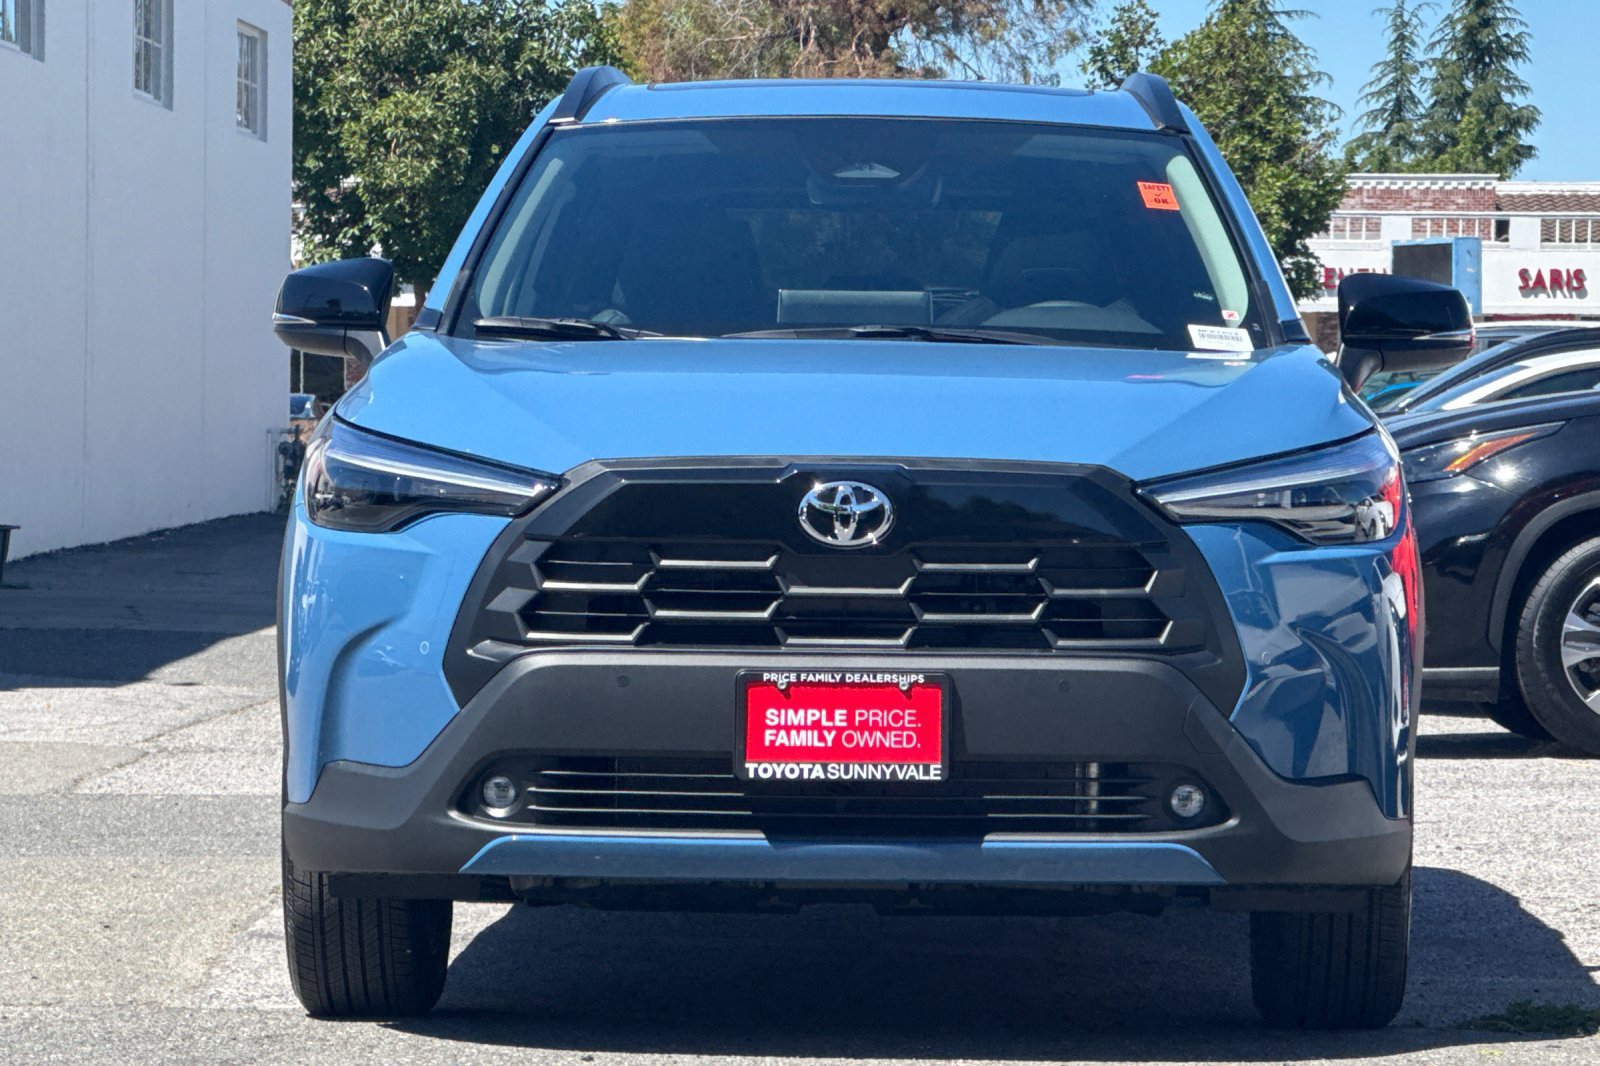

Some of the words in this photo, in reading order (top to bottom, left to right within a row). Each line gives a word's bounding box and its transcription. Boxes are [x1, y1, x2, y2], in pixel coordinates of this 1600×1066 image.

[1518, 268, 1585, 292] SARIS
[763, 672, 797, 682] PRICE
[800, 673, 842, 682] FAMILY
[845, 673, 925, 683] DEALERSHIPS
[765, 708, 848, 726] SIMPLE
[855, 709, 922, 727] PRICE.
[764, 729, 837, 747] FAMILY
[841, 730, 921, 748] OWNED.
[745, 763, 825, 779] TOYOTA
[826, 764, 942, 780] SUNNYVALE
